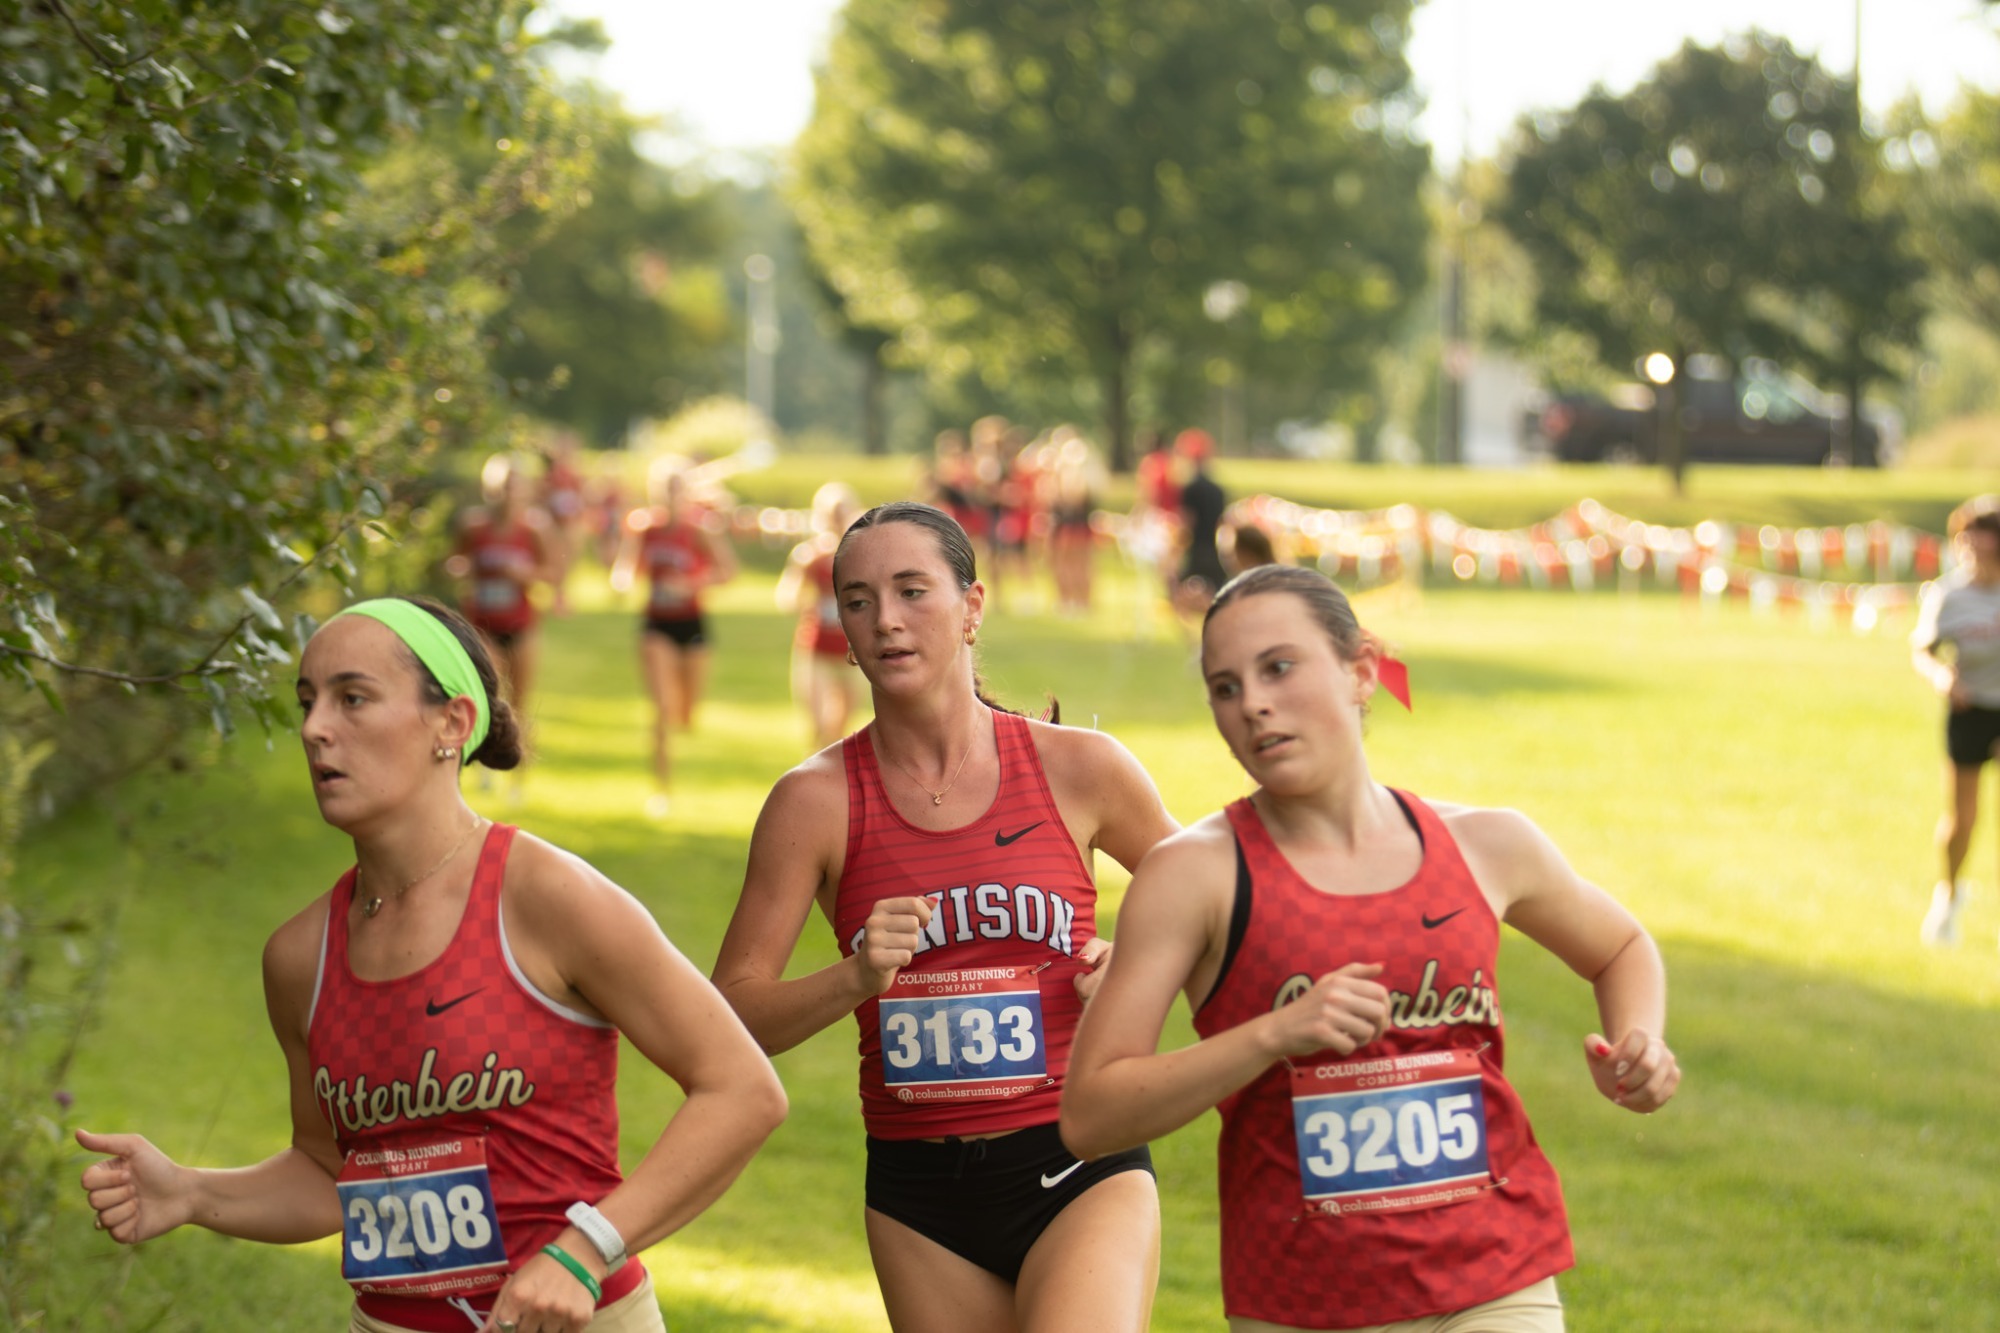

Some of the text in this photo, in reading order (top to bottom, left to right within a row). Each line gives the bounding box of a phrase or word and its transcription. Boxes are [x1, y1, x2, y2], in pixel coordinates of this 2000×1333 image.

[849, 882, 1075, 958] NISON
[897, 968, 1016, 985] COLUMBUS RUNNING
[928, 983, 983, 994] COMPANY
[886, 1005, 1036, 1069] 3133
[1315, 1051, 1455, 1079] COLUMBUS RUNNING
[1356, 1070, 1420, 1087] COMPANY
[314, 1048, 535, 1140] Otterbein
[915, 1085, 1034, 1100] columbusrunning.com
[1304, 1093, 1479, 1178] 3205
[407, 1141, 462, 1160] RUNNING
[1343, 1185, 1479, 1212] columbusrunning.com
[348, 1184, 492, 1262] 3208
